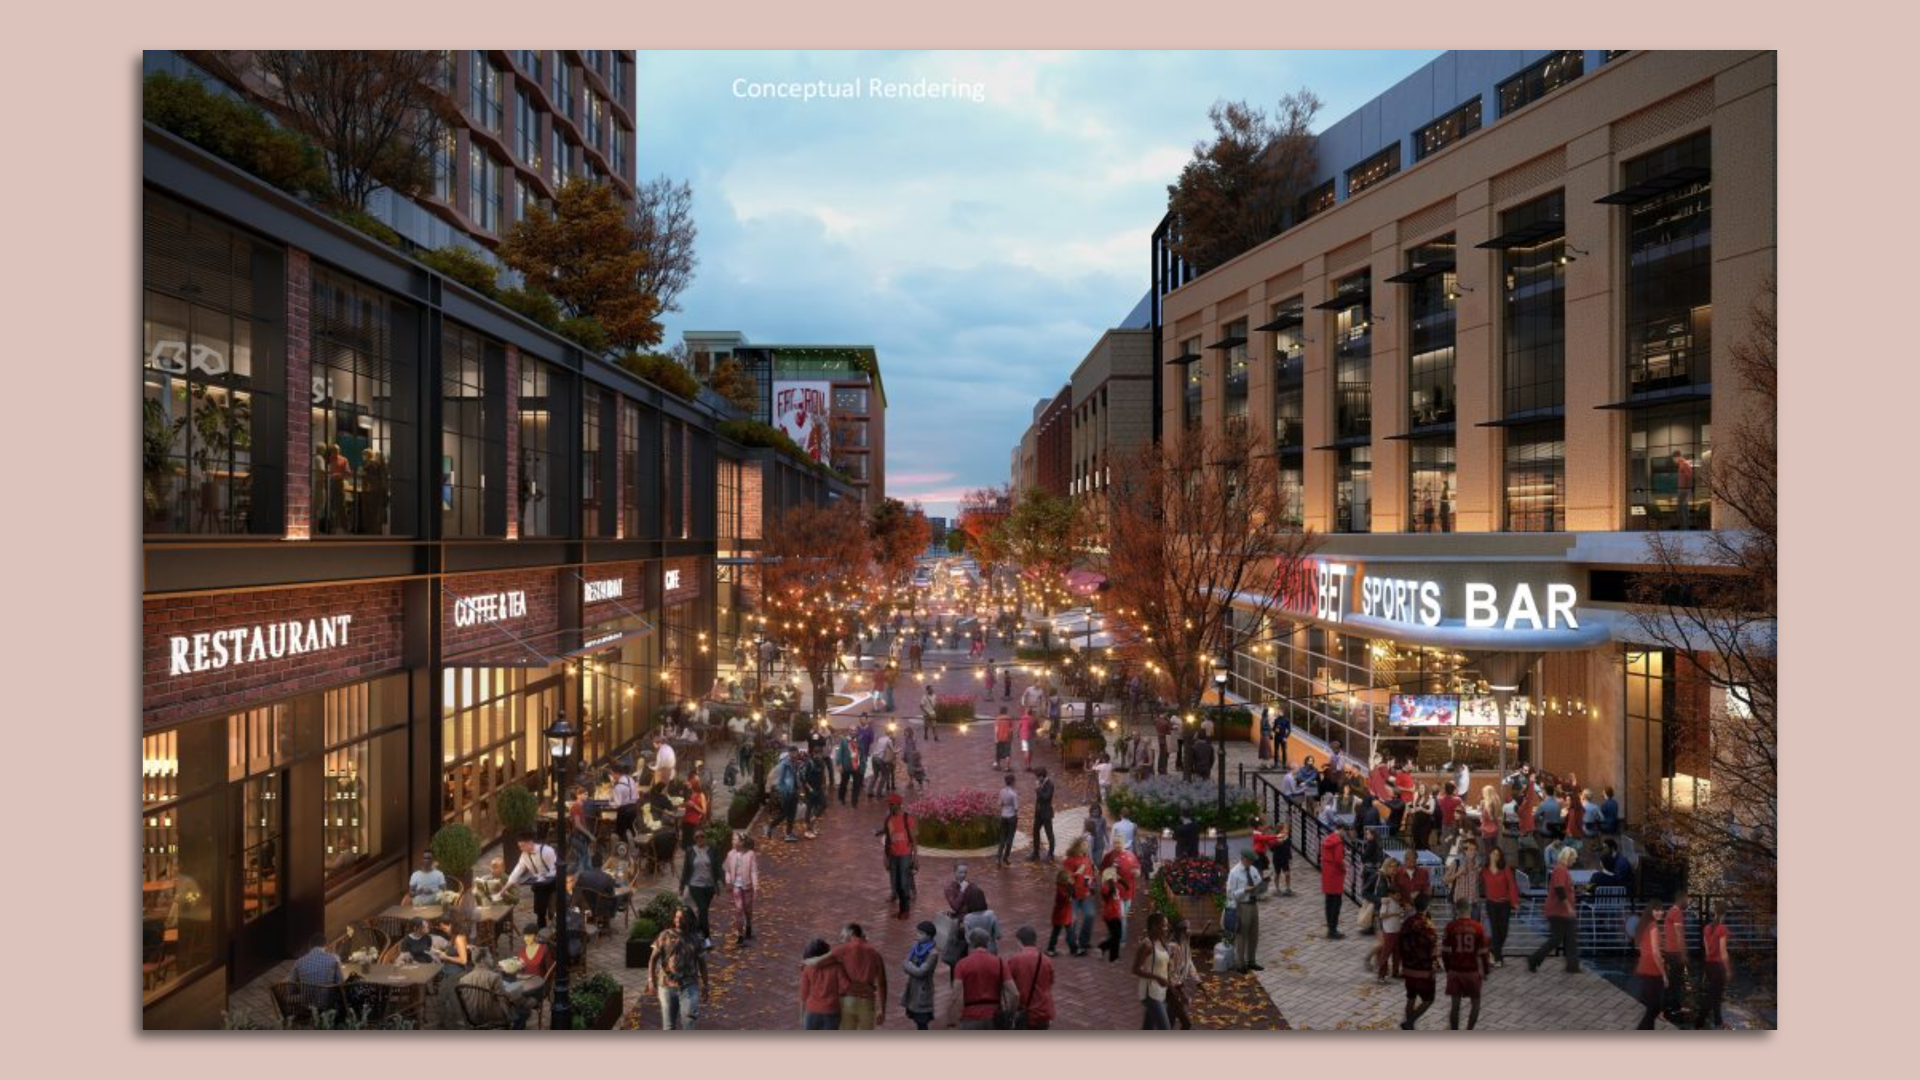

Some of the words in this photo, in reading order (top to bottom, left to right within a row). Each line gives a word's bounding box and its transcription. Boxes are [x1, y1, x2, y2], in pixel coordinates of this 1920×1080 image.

[455, 594, 498, 627] COFFEE
[499, 592, 507, 619] &
[508, 589, 526, 617] TEA
[1362, 576, 1441, 627] SPORTS
[1465, 583, 1578, 631] BAR
[170, 615, 352, 676] RESTAURANT
[1455, 933, 1475, 953] 19
